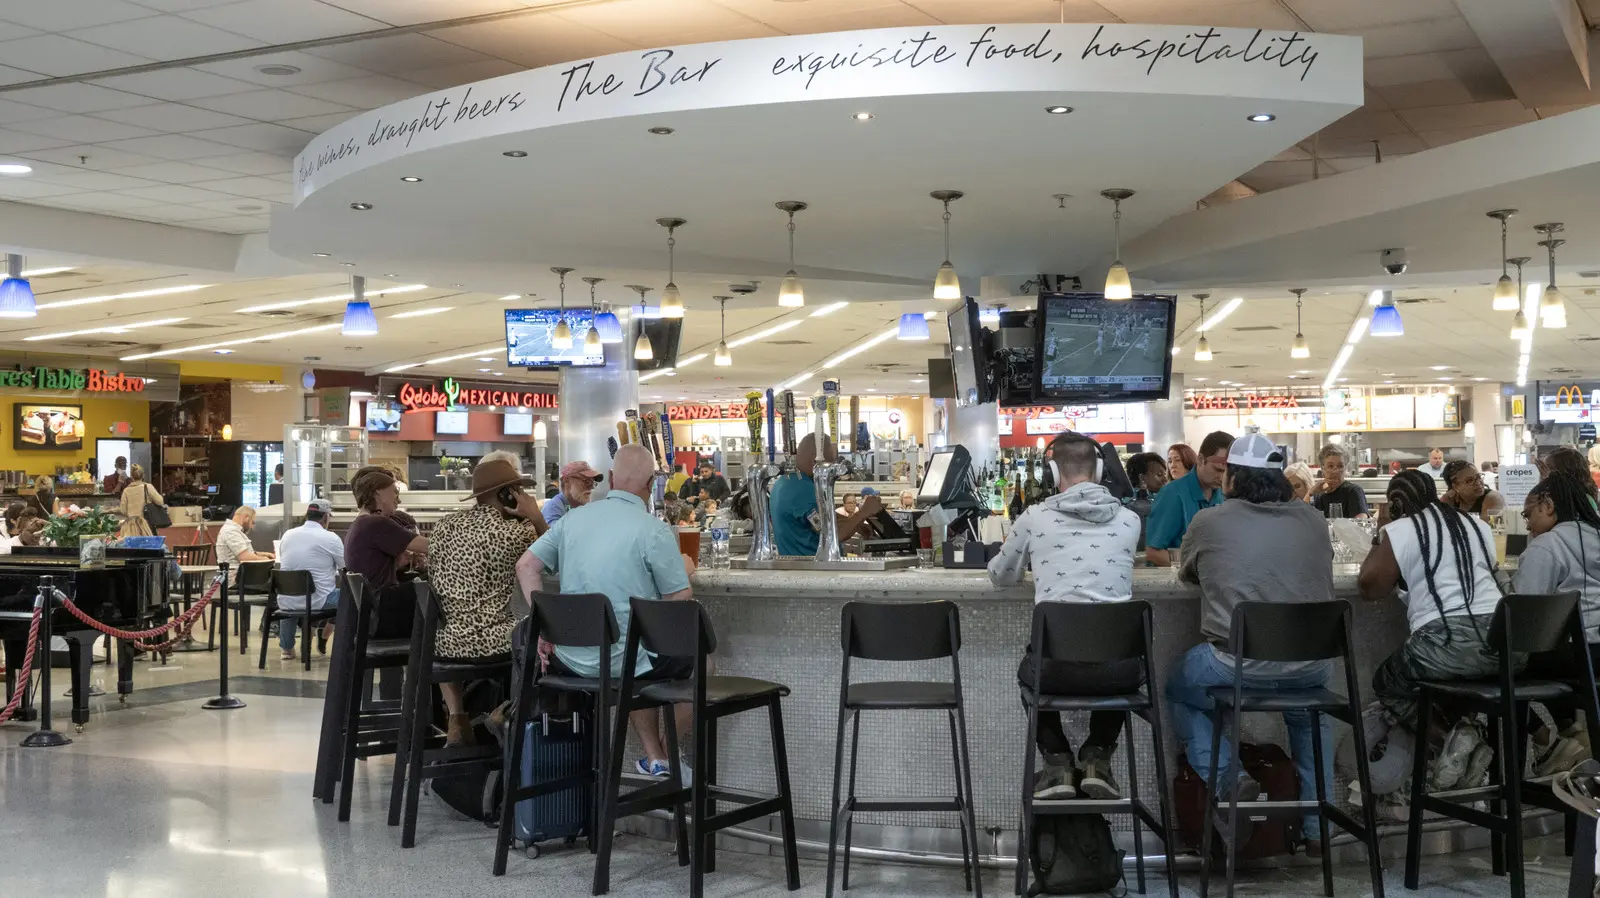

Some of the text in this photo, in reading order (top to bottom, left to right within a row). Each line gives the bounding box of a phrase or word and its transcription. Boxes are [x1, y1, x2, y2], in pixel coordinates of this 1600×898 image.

[367, 97, 450, 148] draught
[453, 87, 527, 123] beers
[557, 60, 624, 112] The
[634, 49, 723, 97] Bar
[772, 31, 957, 90] exquisite
[964, 27, 1062, 68] food,
[1082, 25, 1320, 82] hospitality
[35, 366, 85, 390] Table
[87, 368, 145, 392] Bistro
[400, 382, 559, 414] Qdoba MEXICAN GRILL
[667, 404, 723, 420] PANDA
[662, 421, 670, 440] LIGHT
